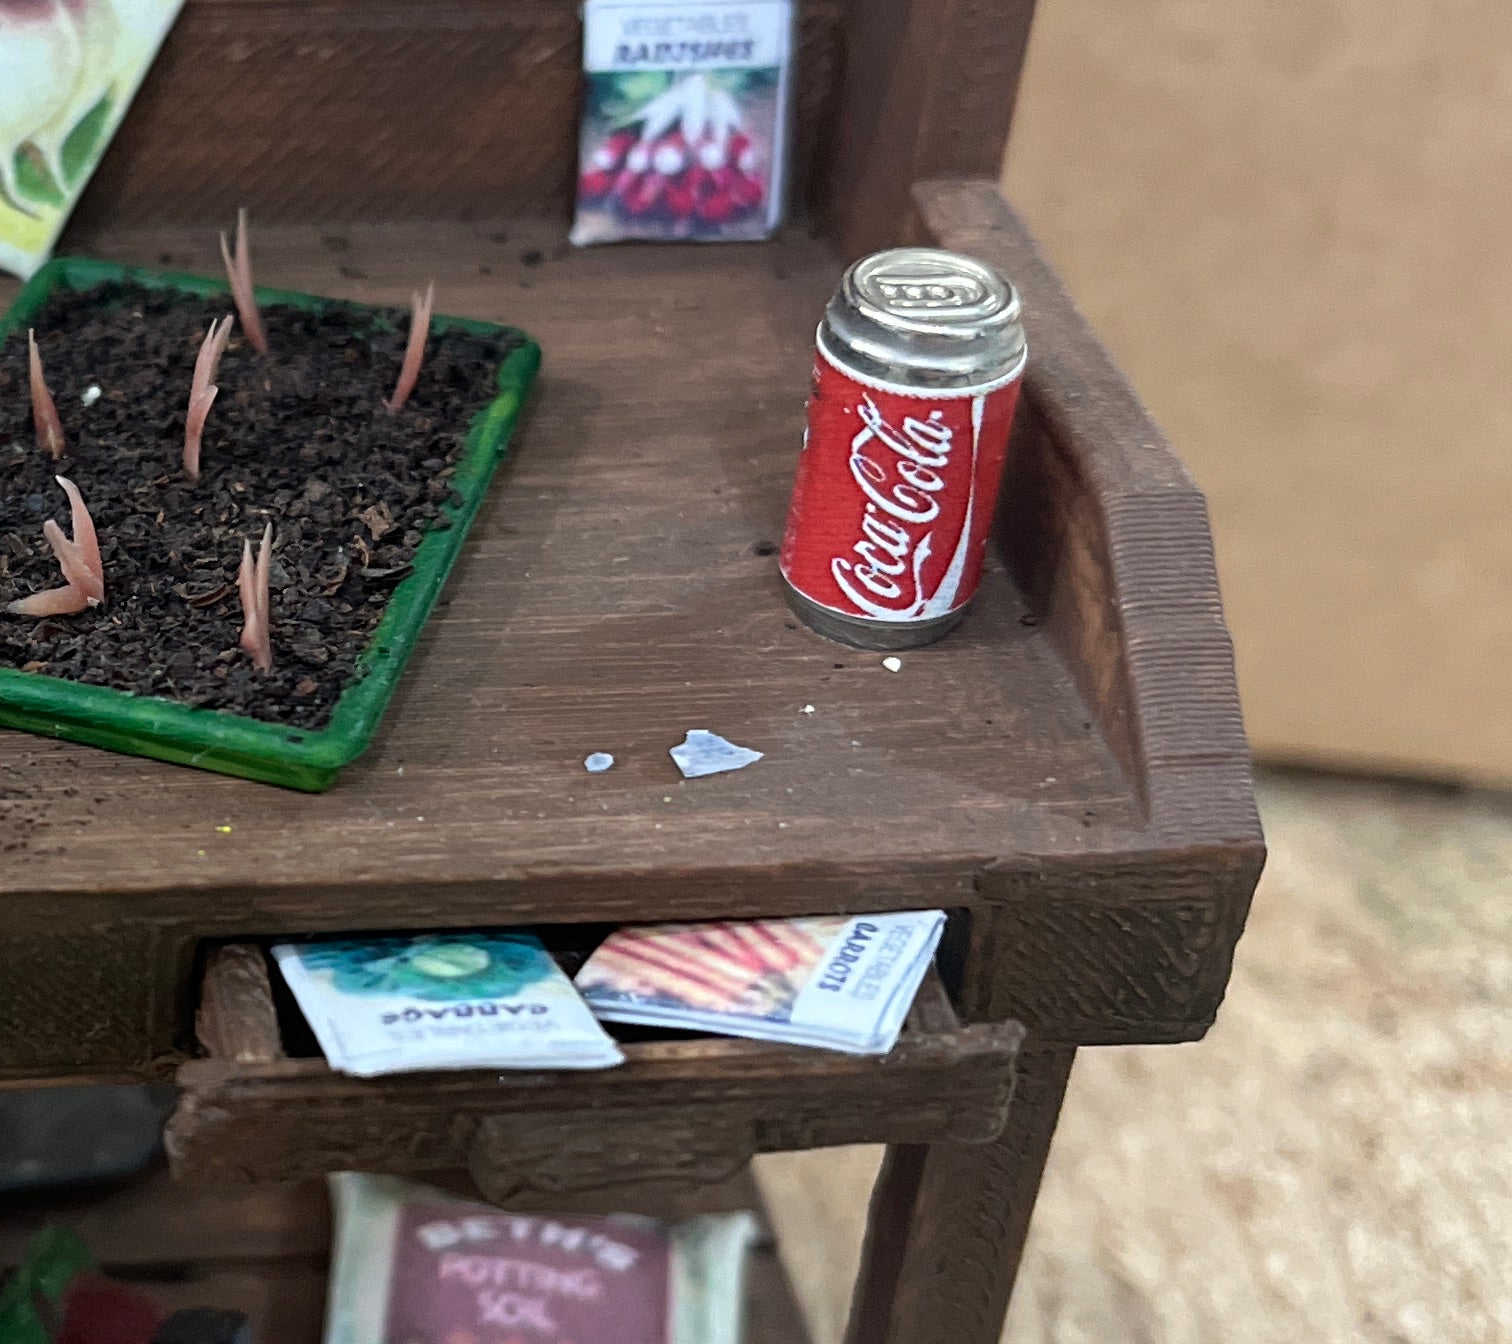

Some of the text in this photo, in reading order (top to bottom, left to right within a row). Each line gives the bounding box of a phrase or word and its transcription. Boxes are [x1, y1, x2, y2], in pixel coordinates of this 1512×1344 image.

[830, 392, 954, 621] Coca-Cola
[817, 922, 878, 992] CARROTS
[381, 1003, 549, 1025] CABBAGE
[438, 1253, 604, 1299] POTTING
[476, 1290, 559, 1332] SOIL
